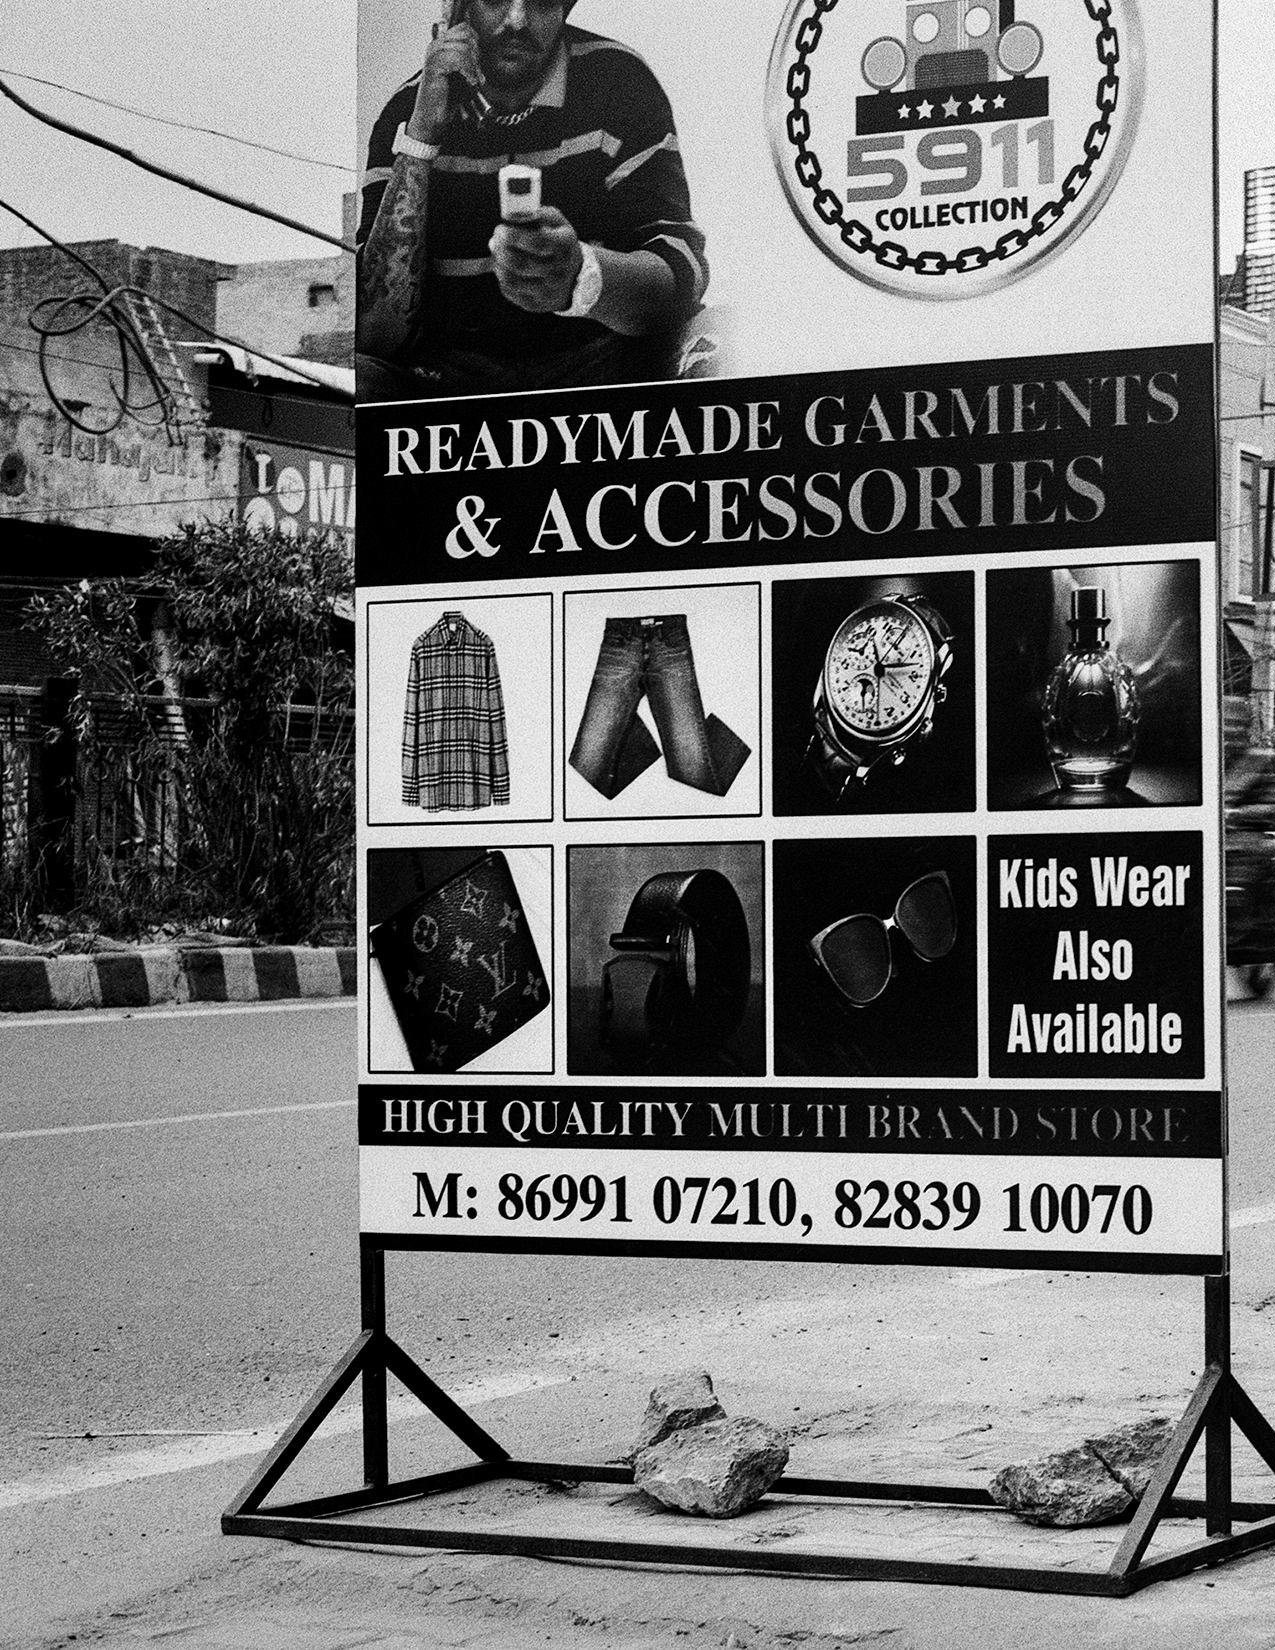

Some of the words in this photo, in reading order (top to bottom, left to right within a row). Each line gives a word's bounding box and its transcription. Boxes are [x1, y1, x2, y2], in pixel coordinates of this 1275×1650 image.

[847, 119, 1055, 203] 5911
[876, 196, 1029, 232] COLLECTION
[384, 401, 783, 478] READYMADE
[805, 372, 1180, 447] GARMENTS
[446, 496, 501, 559] &
[529, 454, 1107, 555] ACCESSORIES
[999, 858, 1078, 908] Kids
[1090, 856, 1191, 907] Wear
[1052, 930, 1133, 981] Also
[1006, 1003, 1182, 1055] Available
[383, 1099, 487, 1134] HIGH
[501, 1100, 692, 1143] QUALITY
[708, 1102, 847, 1138] MULTI
[868, 1104, 1019, 1139] BRAND
[1036, 1107, 1189, 1142] STORE
[412, 1172, 478, 1219] M:
[498, 1173, 632, 1222] 86991
[653, 1175, 813, 1236] 07210,
[834, 1179, 980, 1231] 82839
[1003, 1183, 1153, 1235] 10070
